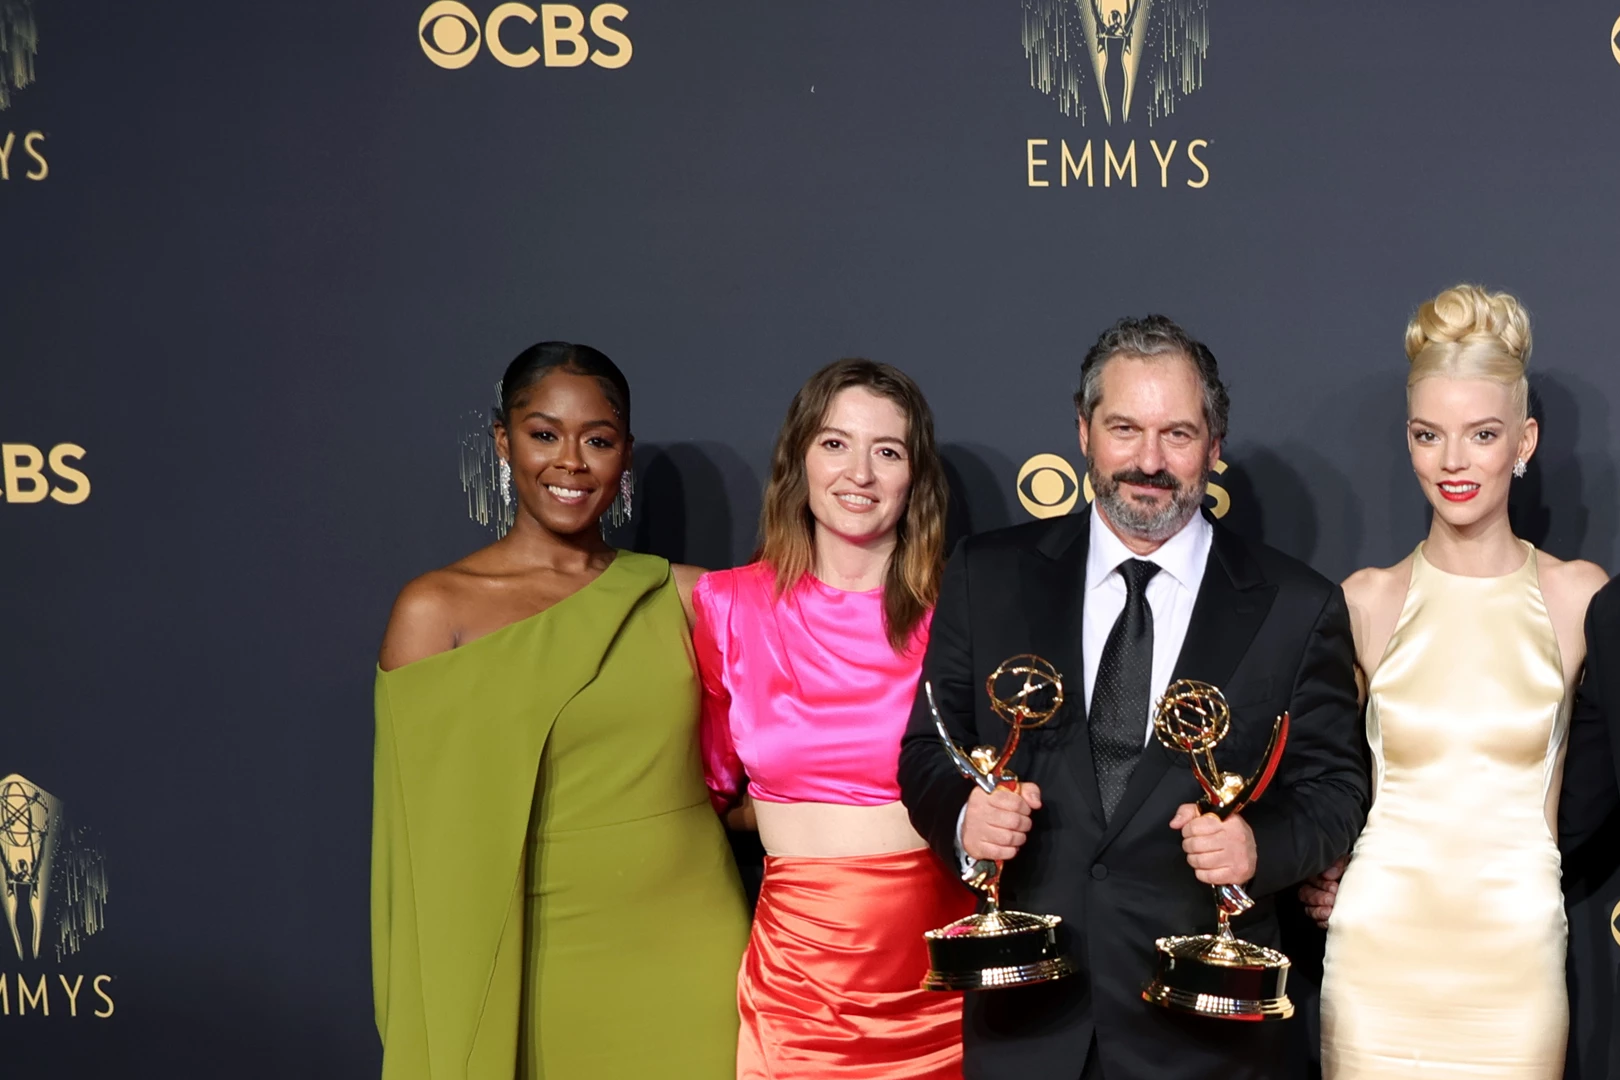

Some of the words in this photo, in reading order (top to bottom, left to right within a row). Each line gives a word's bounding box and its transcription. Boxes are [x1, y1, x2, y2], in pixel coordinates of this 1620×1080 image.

[485, 1, 634, 69] CBS
[1026, 138, 1210, 188] EMMYS
[0, 442, 92, 506] BS
